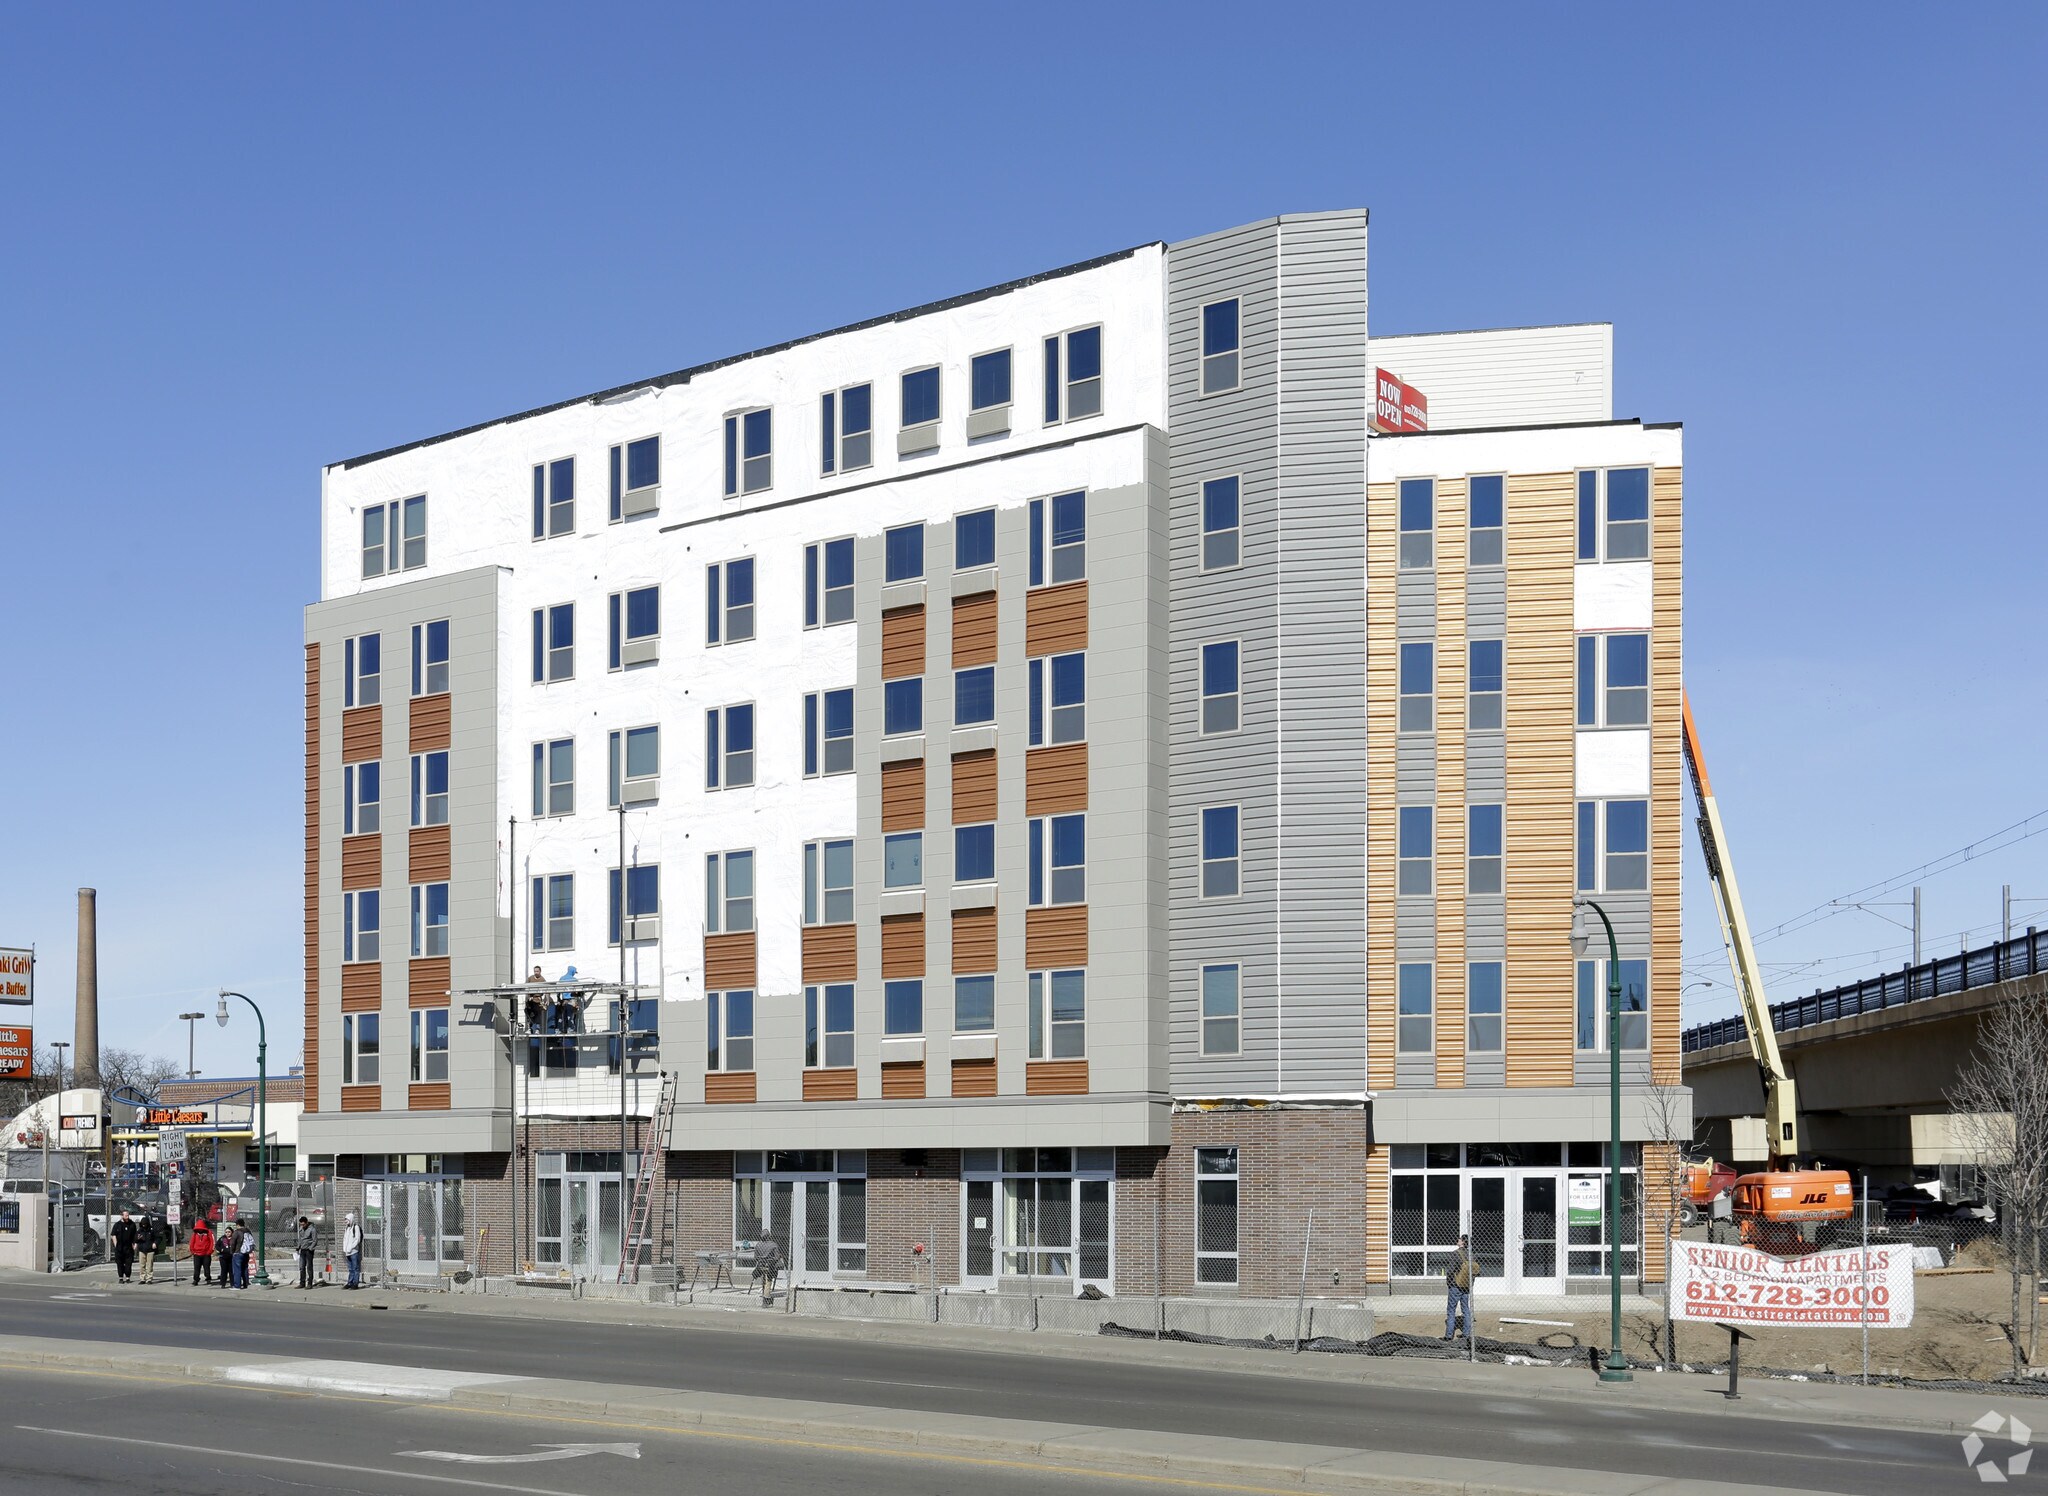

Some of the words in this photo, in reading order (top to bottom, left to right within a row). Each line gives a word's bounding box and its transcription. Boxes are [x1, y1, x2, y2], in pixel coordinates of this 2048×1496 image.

[1379, 379, 1401, 406] NOW
[1378, 399, 1402, 428] OPEN
[12, 955, 31, 974] Grill
[6, 981, 26, 996] Buffet
[149, 1108, 171, 1123] Little
[172, 1109, 203, 1123] Caesars
[162, 1132, 183, 1141] RIGHT
[163, 1141, 183, 1150] TURN
[164, 1150, 184, 1159] LANE
[1800, 1193, 1828, 1205] JLG
[1687, 1247, 1770, 1273] SENIOR
[1782, 1250, 1889, 1274] RENTALS
[1712, 1270, 1720, 1280] 2
[1724, 1271, 1793, 1284] BEDROOM
[1797, 1272, 1887, 1286] APARTMENTS
[1686, 1281, 1890, 1306] 612-728-3000
